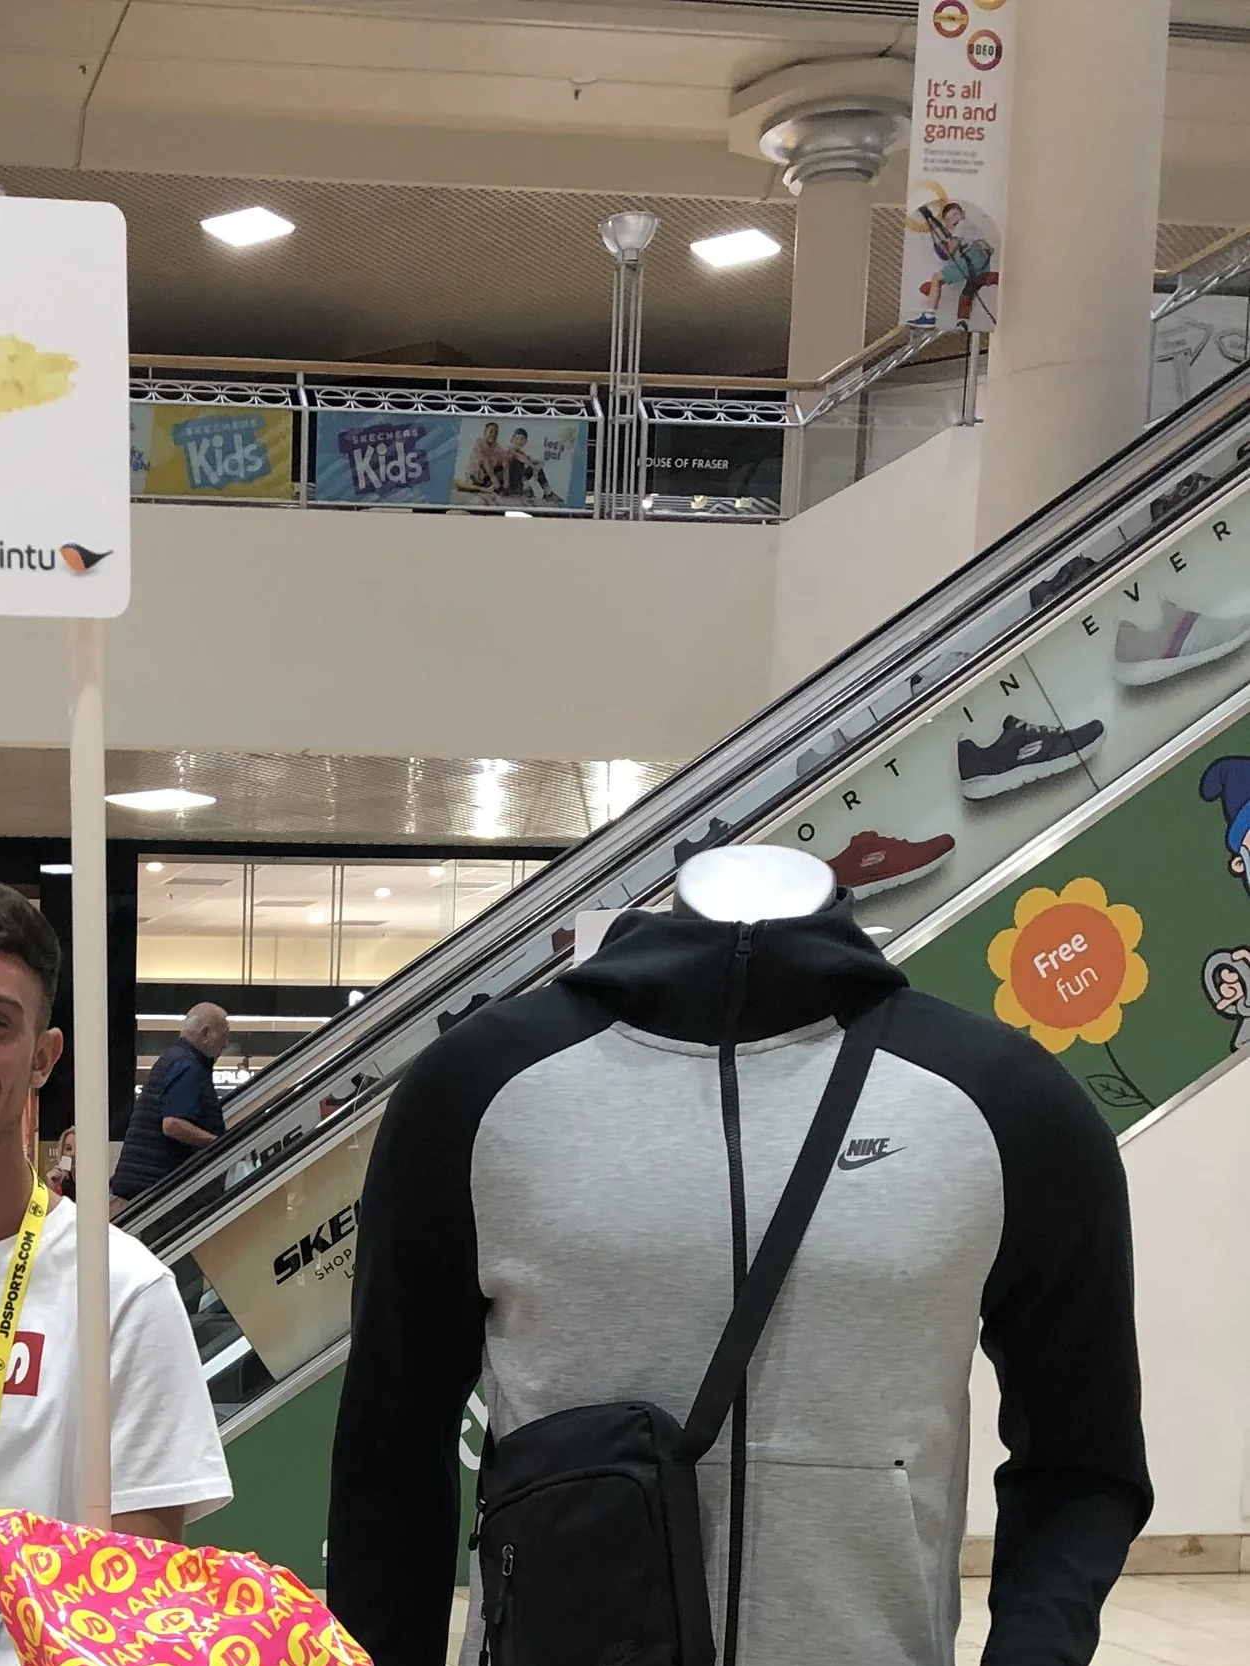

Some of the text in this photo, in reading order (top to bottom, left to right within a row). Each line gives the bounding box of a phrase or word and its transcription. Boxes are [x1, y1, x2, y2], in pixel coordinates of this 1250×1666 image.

[927, 79, 982, 99] It's all
[926, 99, 997, 121] fun and
[924, 124, 985, 144] games
[352, 428, 419, 445] SKECHERS
[187, 433, 263, 485] Kids
[353, 441, 423, 490] Kids
[675, 458, 689, 468] OF
[692, 458, 729, 469] FRASER
[0, 541, 56, 571] intu
[797, 758, 900, 842] ORT
[962, 673, 1021, 723] IN
[1033, 933, 1088, 979] Free
[1055, 967, 1099, 1003] fun
[846, 1137, 891, 1157] NIKE
[315, 1249, 352, 1280] SHOP
[101, 1554, 128, 1587] JD
[41, 1574, 95, 1612] I AM
[127, 1577, 173, 1615] AM
[80, 1616, 108, 1637] JD
[160, 1611, 184, 1632] JD
[114, 1630, 157, 1666] AM
